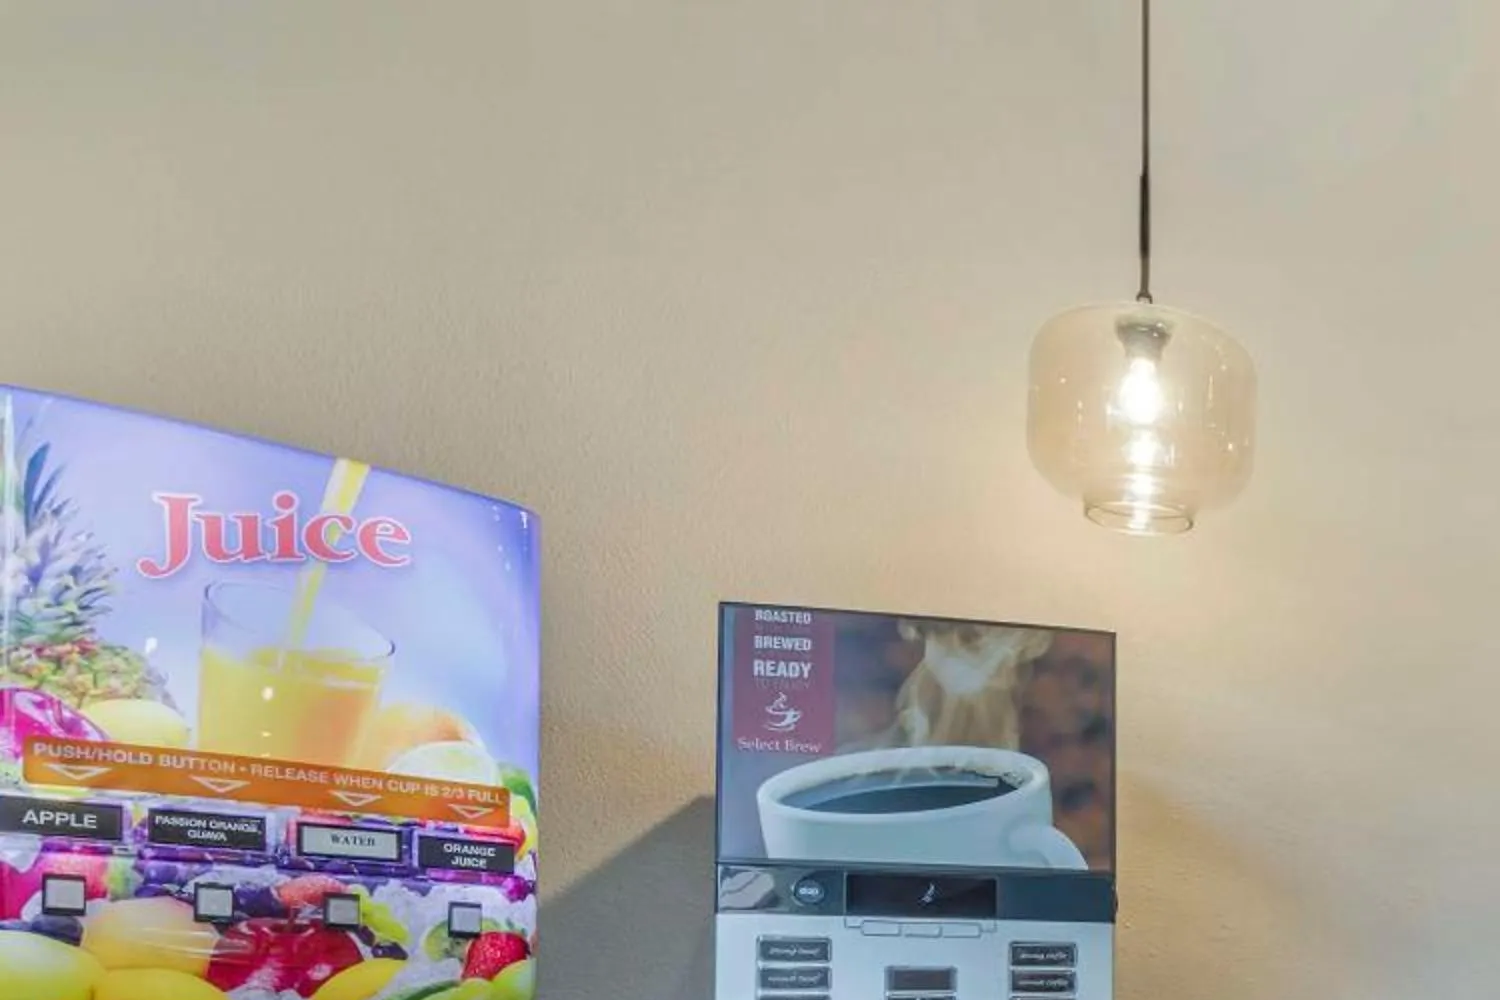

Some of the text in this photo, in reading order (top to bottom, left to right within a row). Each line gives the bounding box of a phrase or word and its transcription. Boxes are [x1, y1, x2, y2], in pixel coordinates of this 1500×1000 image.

[137, 490, 412, 579] Juice
[755, 610, 812, 624] ROASTED
[753, 635, 812, 651] BREWED
[753, 659, 813, 679] READY
[737, 737, 822, 753] Select Brew
[33, 742, 502, 804] PUSH/HOLD BUTTON RELEASE WHEN CUP IS 2/3 FULL
[22, 809, 97, 829] APPLE
[154, 815, 207, 828] PASSION
[187, 829, 228, 842] GUAVA
[329, 832, 376, 848] WATER
[443, 842, 497, 858] ORANGE
[450, 855, 487, 869] JUICE
